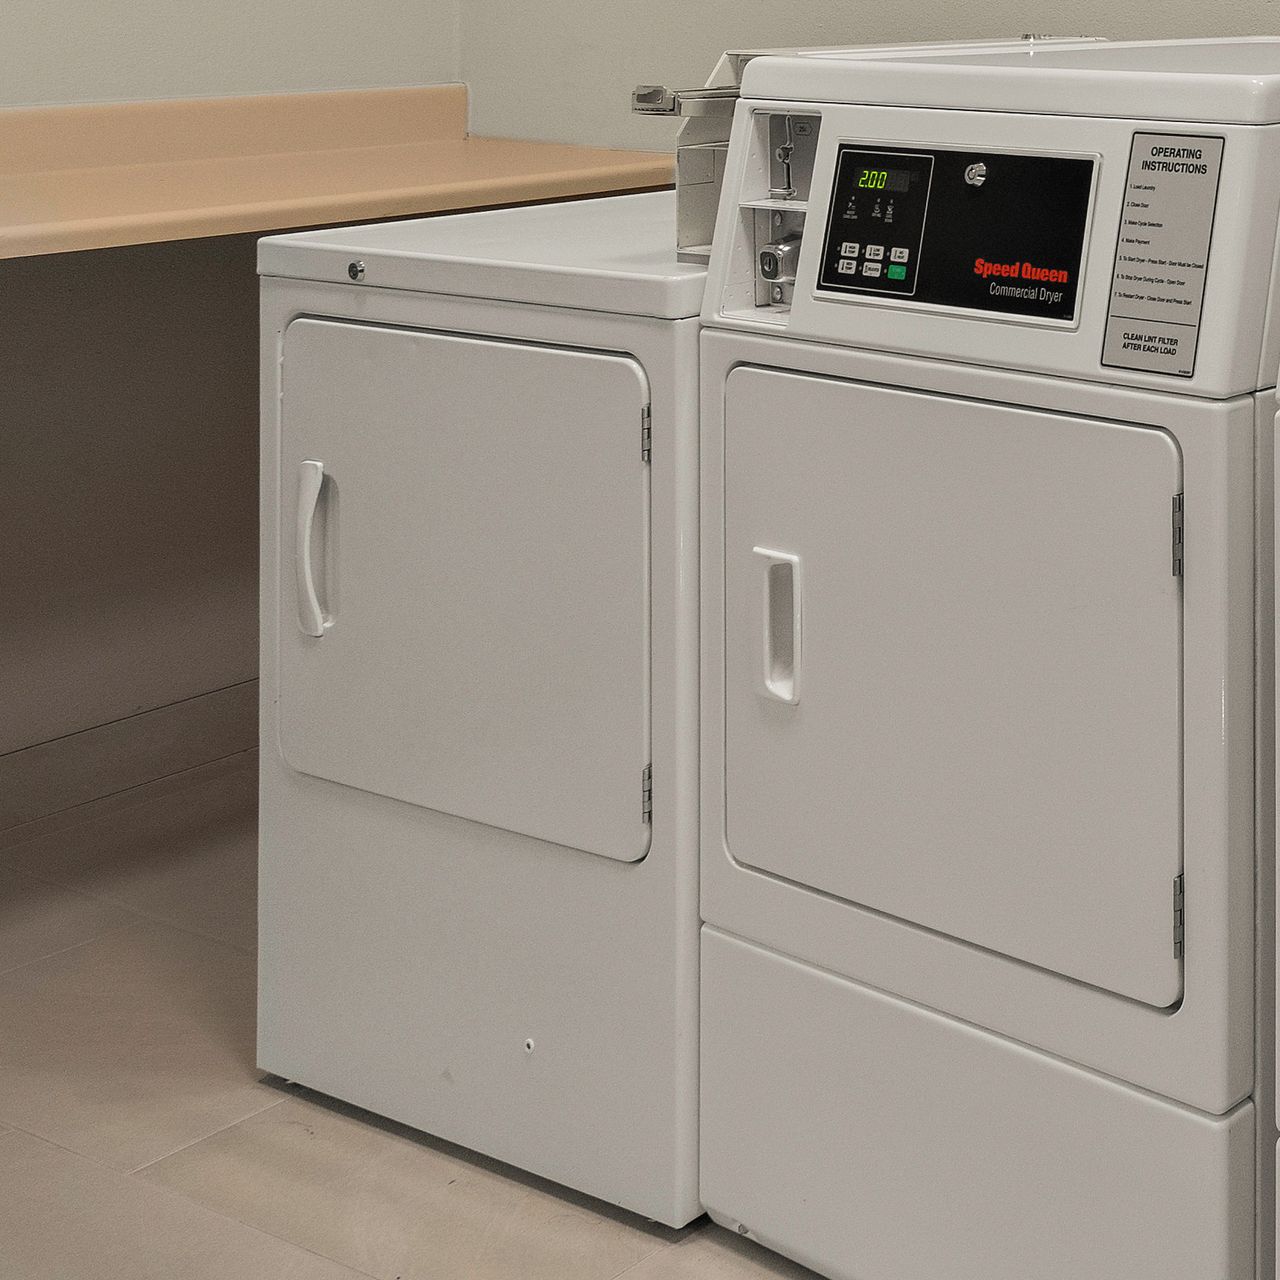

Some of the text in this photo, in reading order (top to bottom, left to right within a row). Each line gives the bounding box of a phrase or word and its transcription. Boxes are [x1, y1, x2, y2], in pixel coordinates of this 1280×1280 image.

[1151, 147, 1202, 159] OPERATING
[1142, 161, 1207, 174] INSTRUCTIONS
[859, 170, 887, 188] 2.00
[974, 258, 1068, 283] Speed Queen
[990, 282, 1063, 304] Commercial Dryer
[1123, 333, 1178, 345] CLEAN LINT FILTER
[1122, 343, 1176, 355] AFTER EACH LOAD
